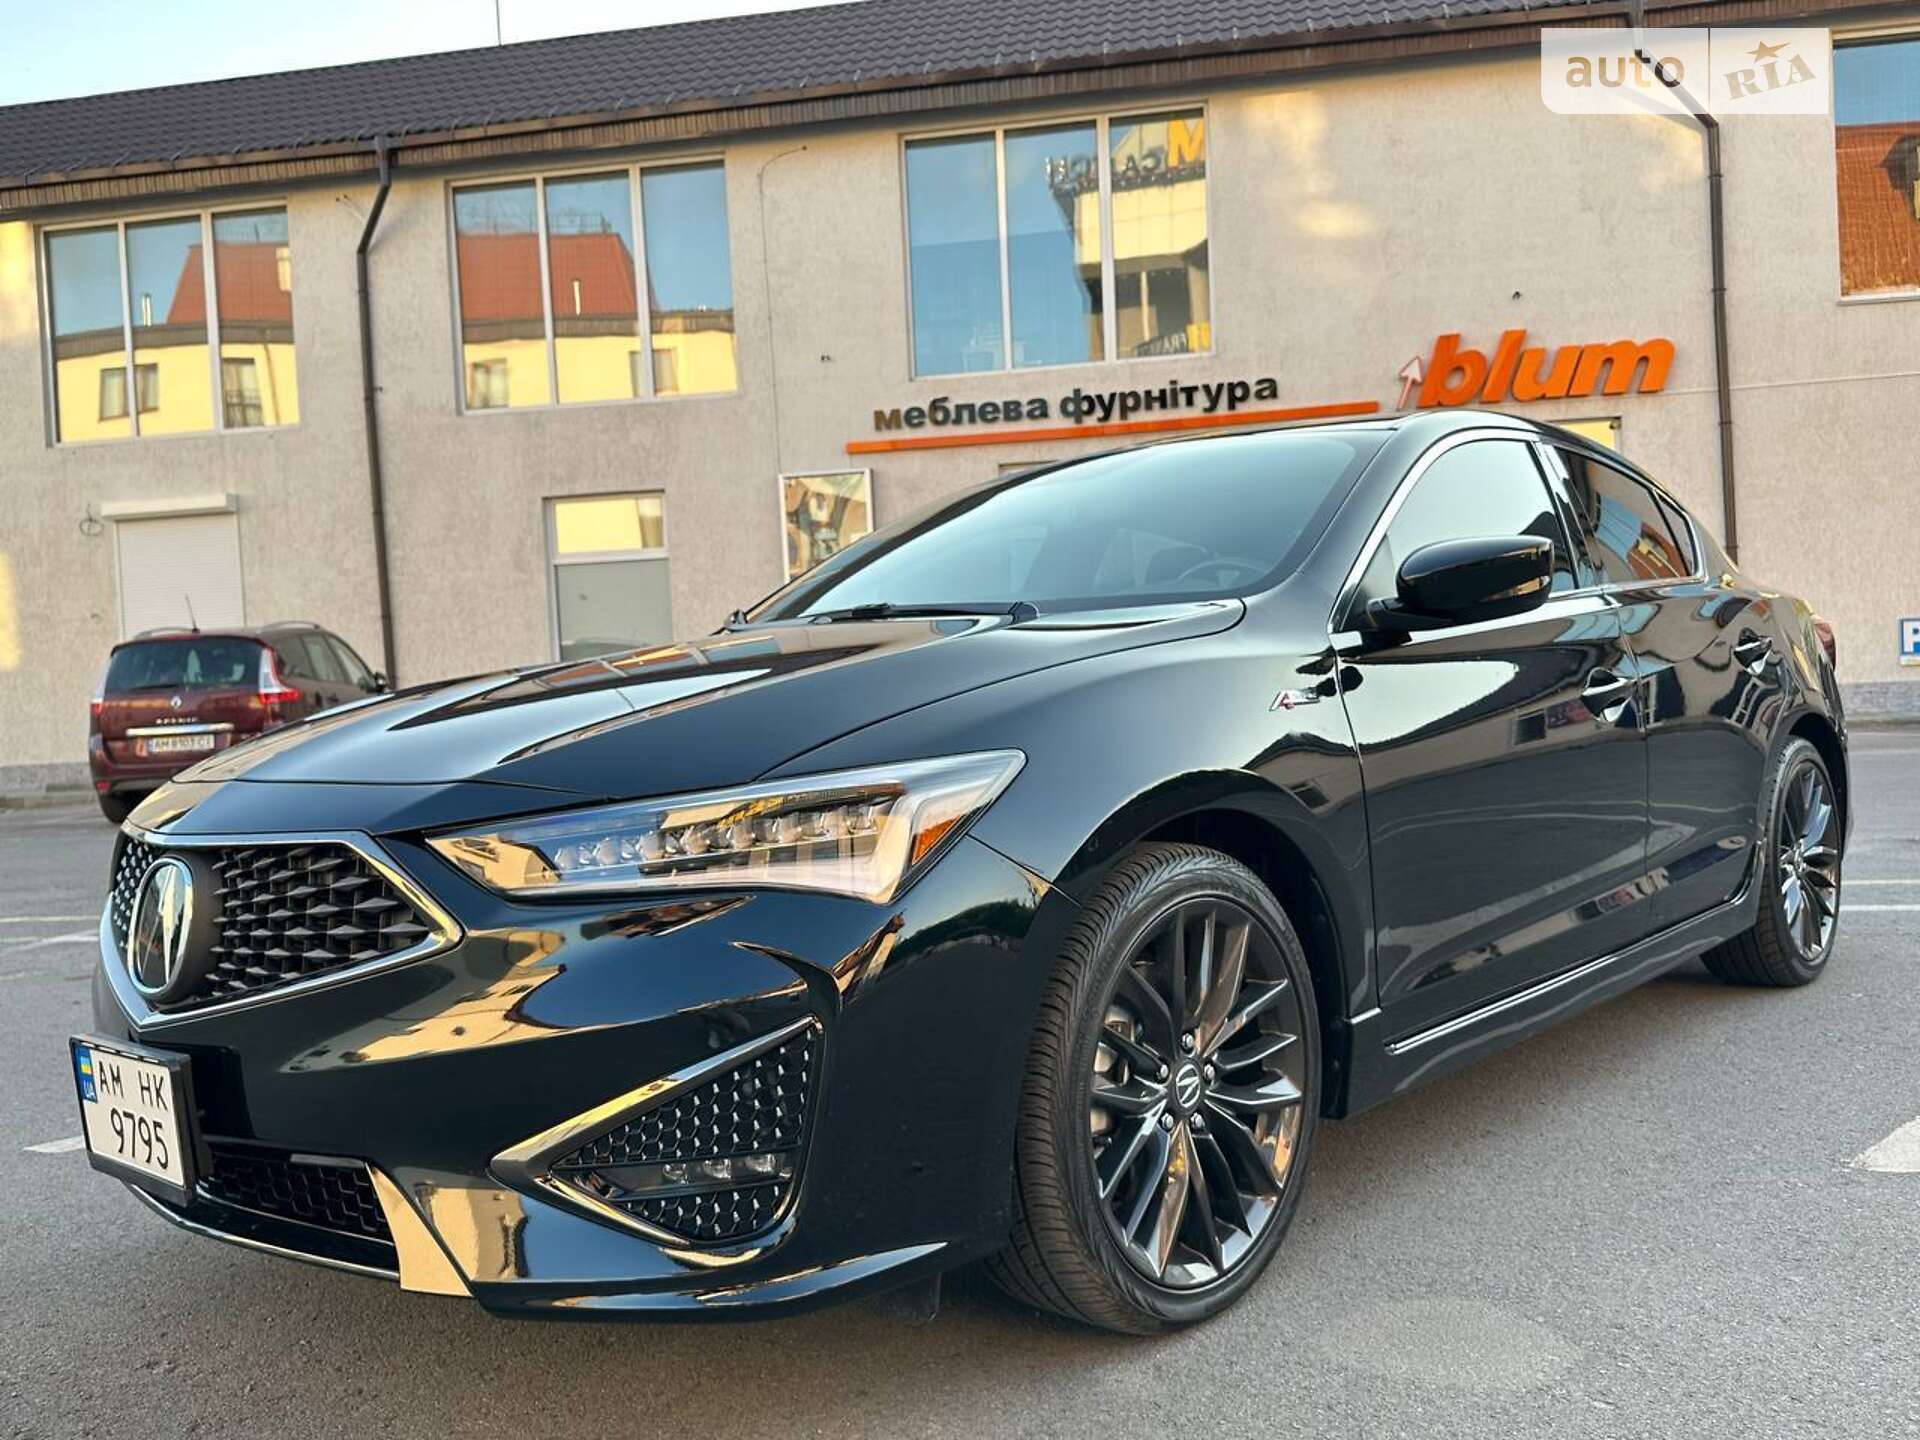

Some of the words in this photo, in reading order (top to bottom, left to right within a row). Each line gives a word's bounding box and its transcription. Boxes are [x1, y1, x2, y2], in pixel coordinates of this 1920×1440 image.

[1417, 329, 1675, 408] blum
[874, 396, 1049, 431] меблева
[1059, 377, 1279, 424] фурнітура
[98, 1060, 124, 1099] AM
[138, 1070, 168, 1112] HK
[110, 1107, 169, 1170] 9795
